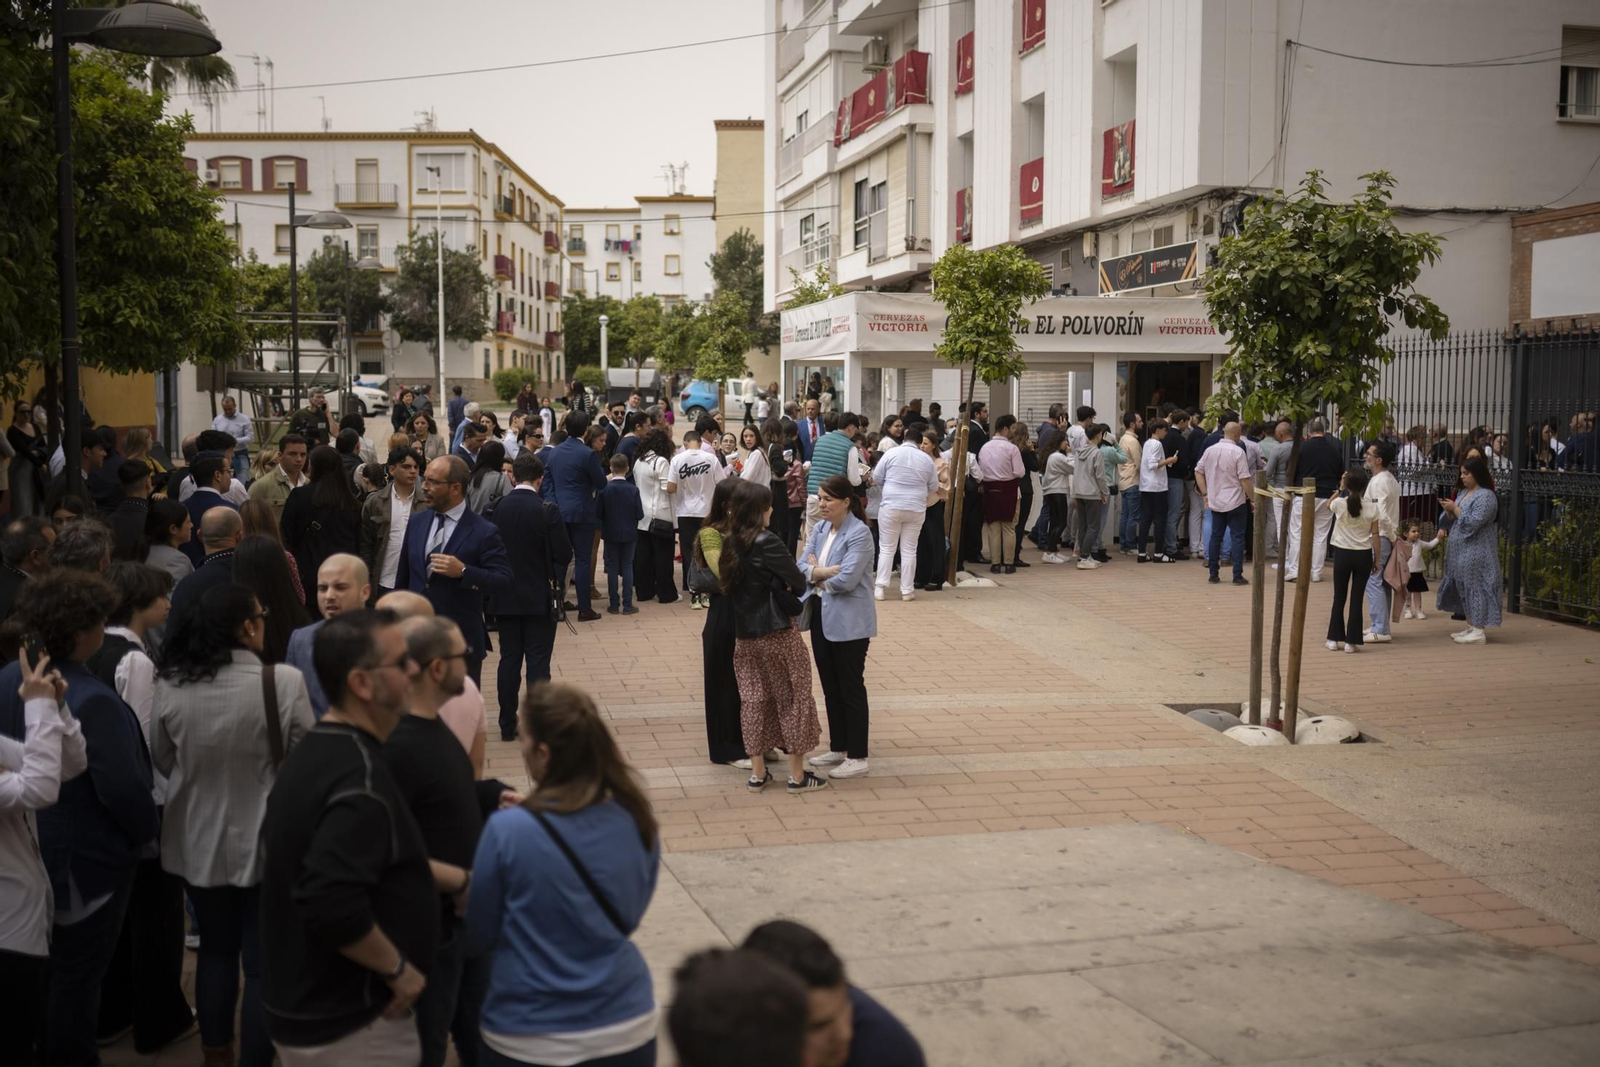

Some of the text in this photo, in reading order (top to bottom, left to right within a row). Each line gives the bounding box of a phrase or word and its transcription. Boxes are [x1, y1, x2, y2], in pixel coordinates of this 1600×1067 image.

[873, 314, 925, 322] CERVEZAS
[868, 323, 929, 332] VICTORIA
[1034, 315, 1056, 335] EL
[1060, 310, 1145, 336] POLVORÍN
[1159, 326, 1216, 335] VICTORIA
